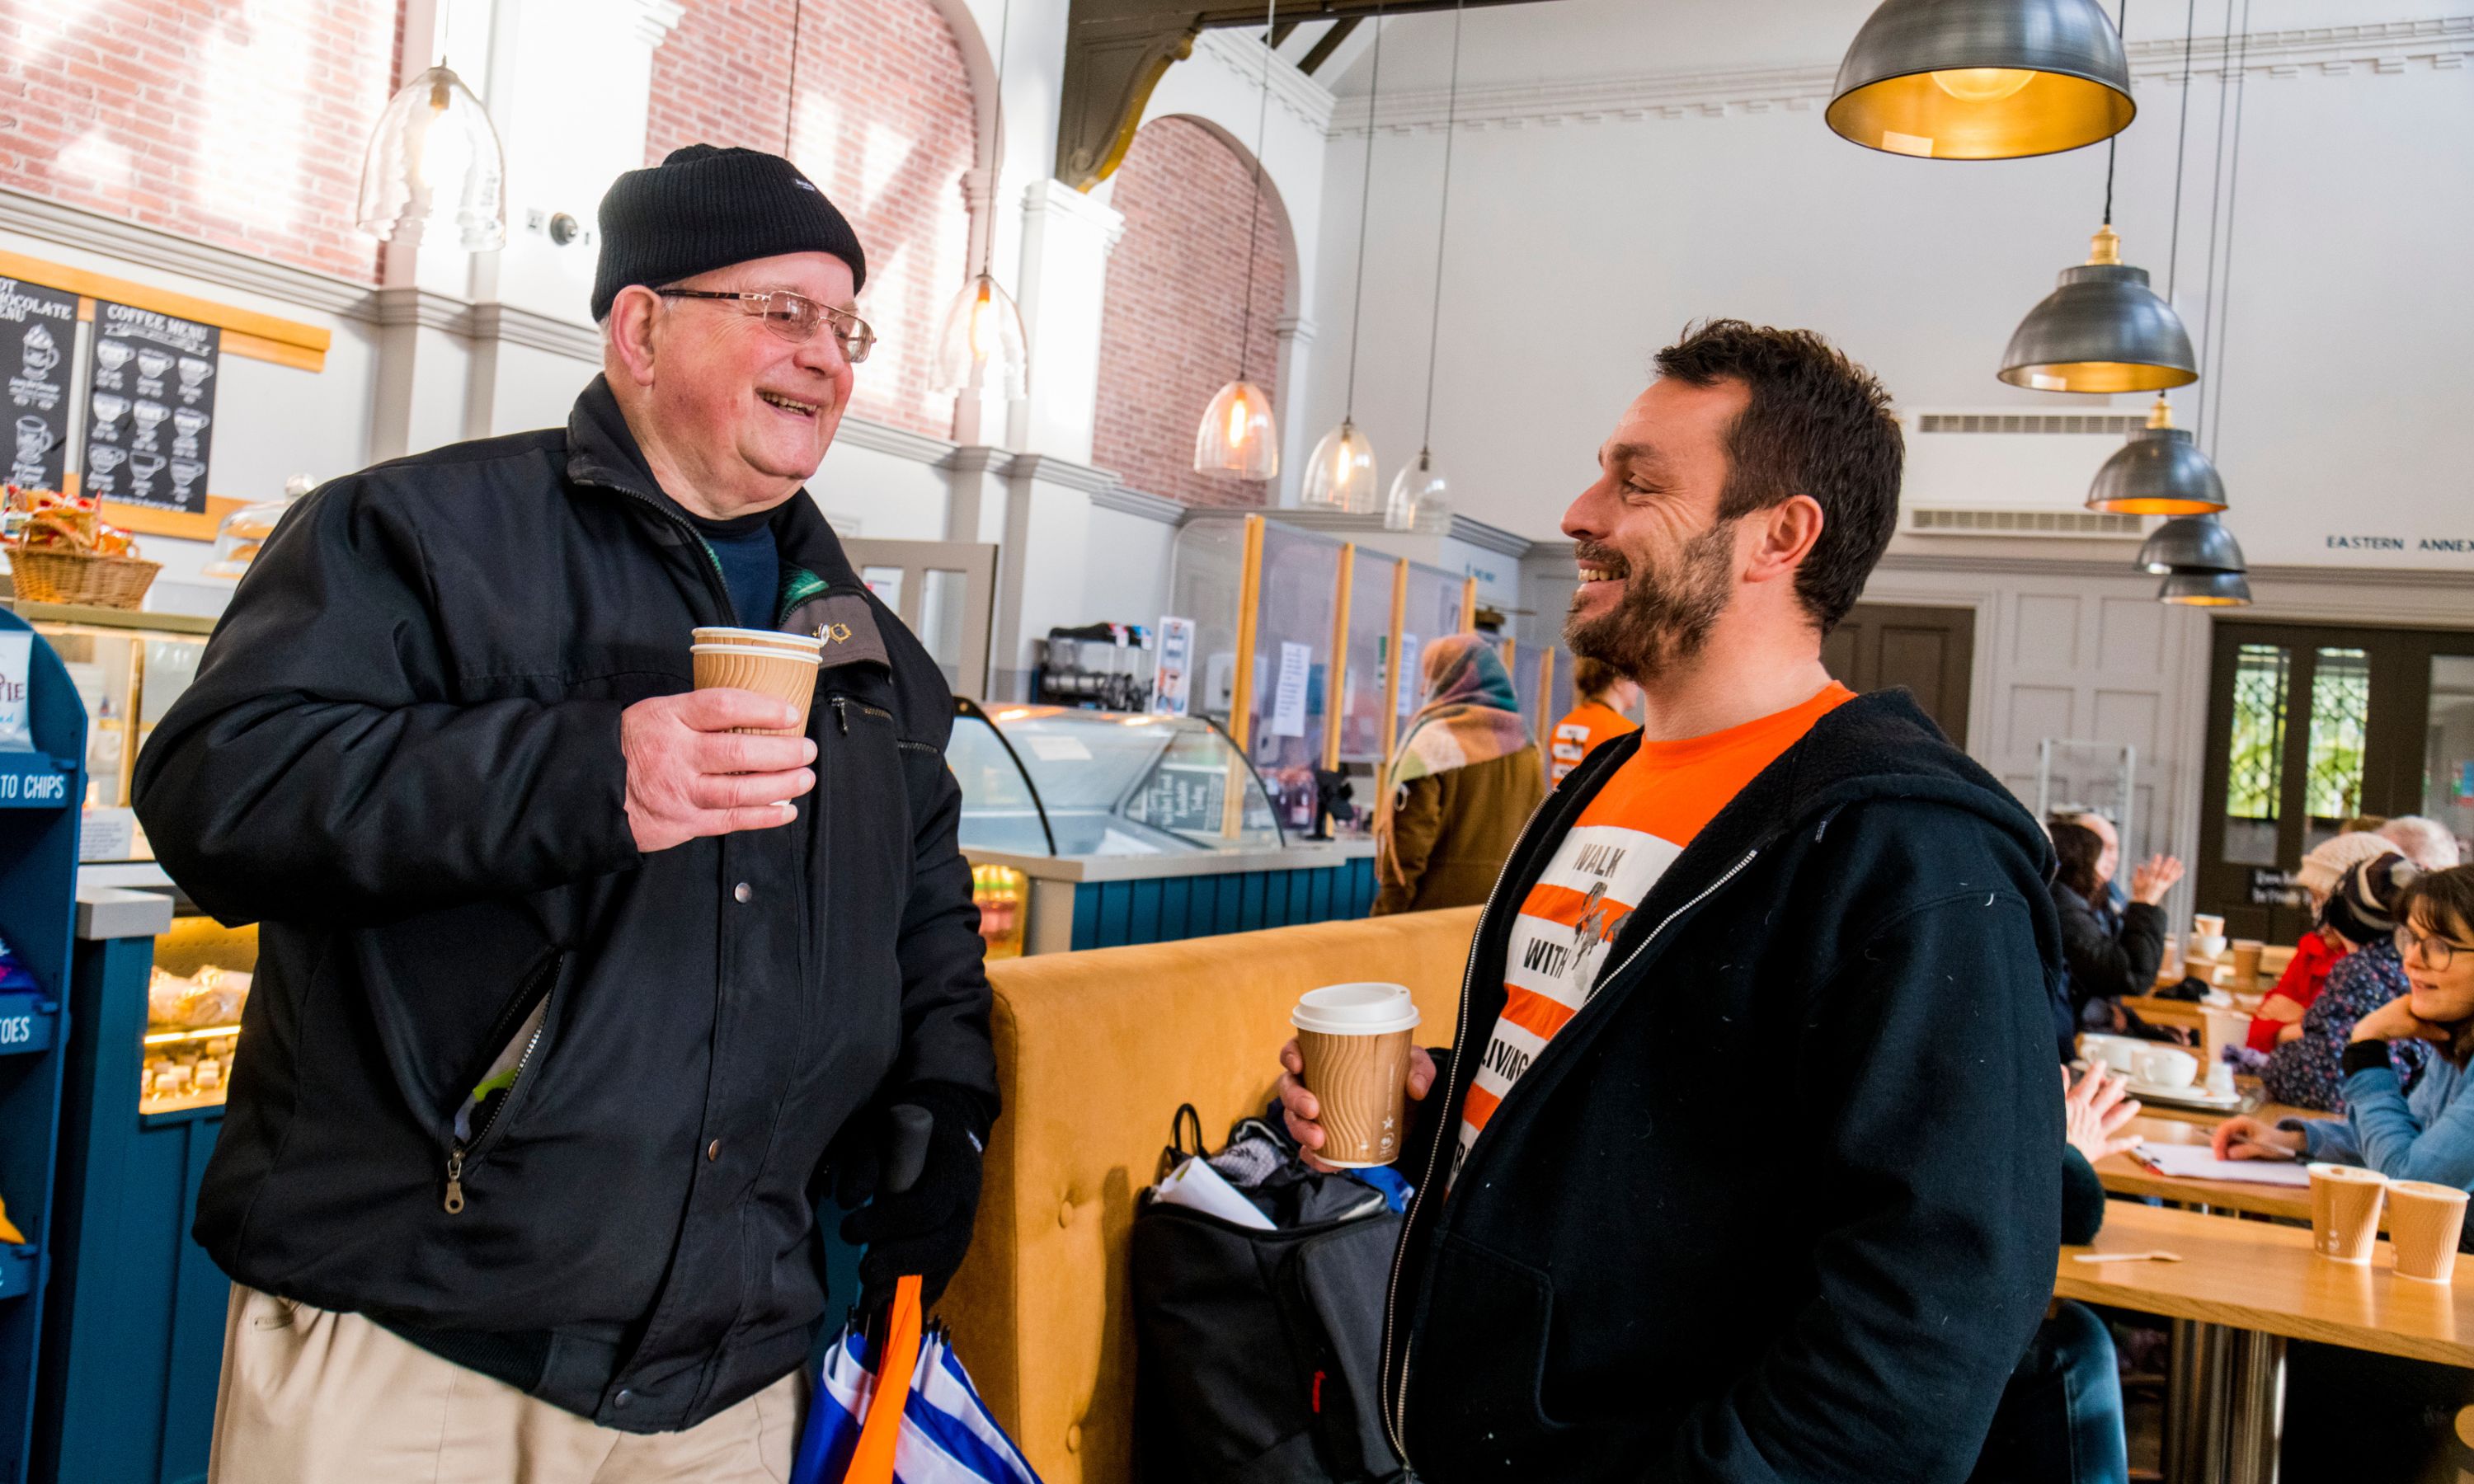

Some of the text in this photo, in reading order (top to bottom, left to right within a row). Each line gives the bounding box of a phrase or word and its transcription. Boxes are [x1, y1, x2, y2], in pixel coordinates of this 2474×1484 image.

[107, 303, 166, 331] COFFEE
[166, 317, 208, 342] MENU
[2326, 535, 2404, 551] EASTERN
[23, 773, 65, 800] CHIPS
[1573, 843, 1626, 879] WALK
[1523, 937, 1572, 979] WITH
[0, 1015, 31, 1044] OES
